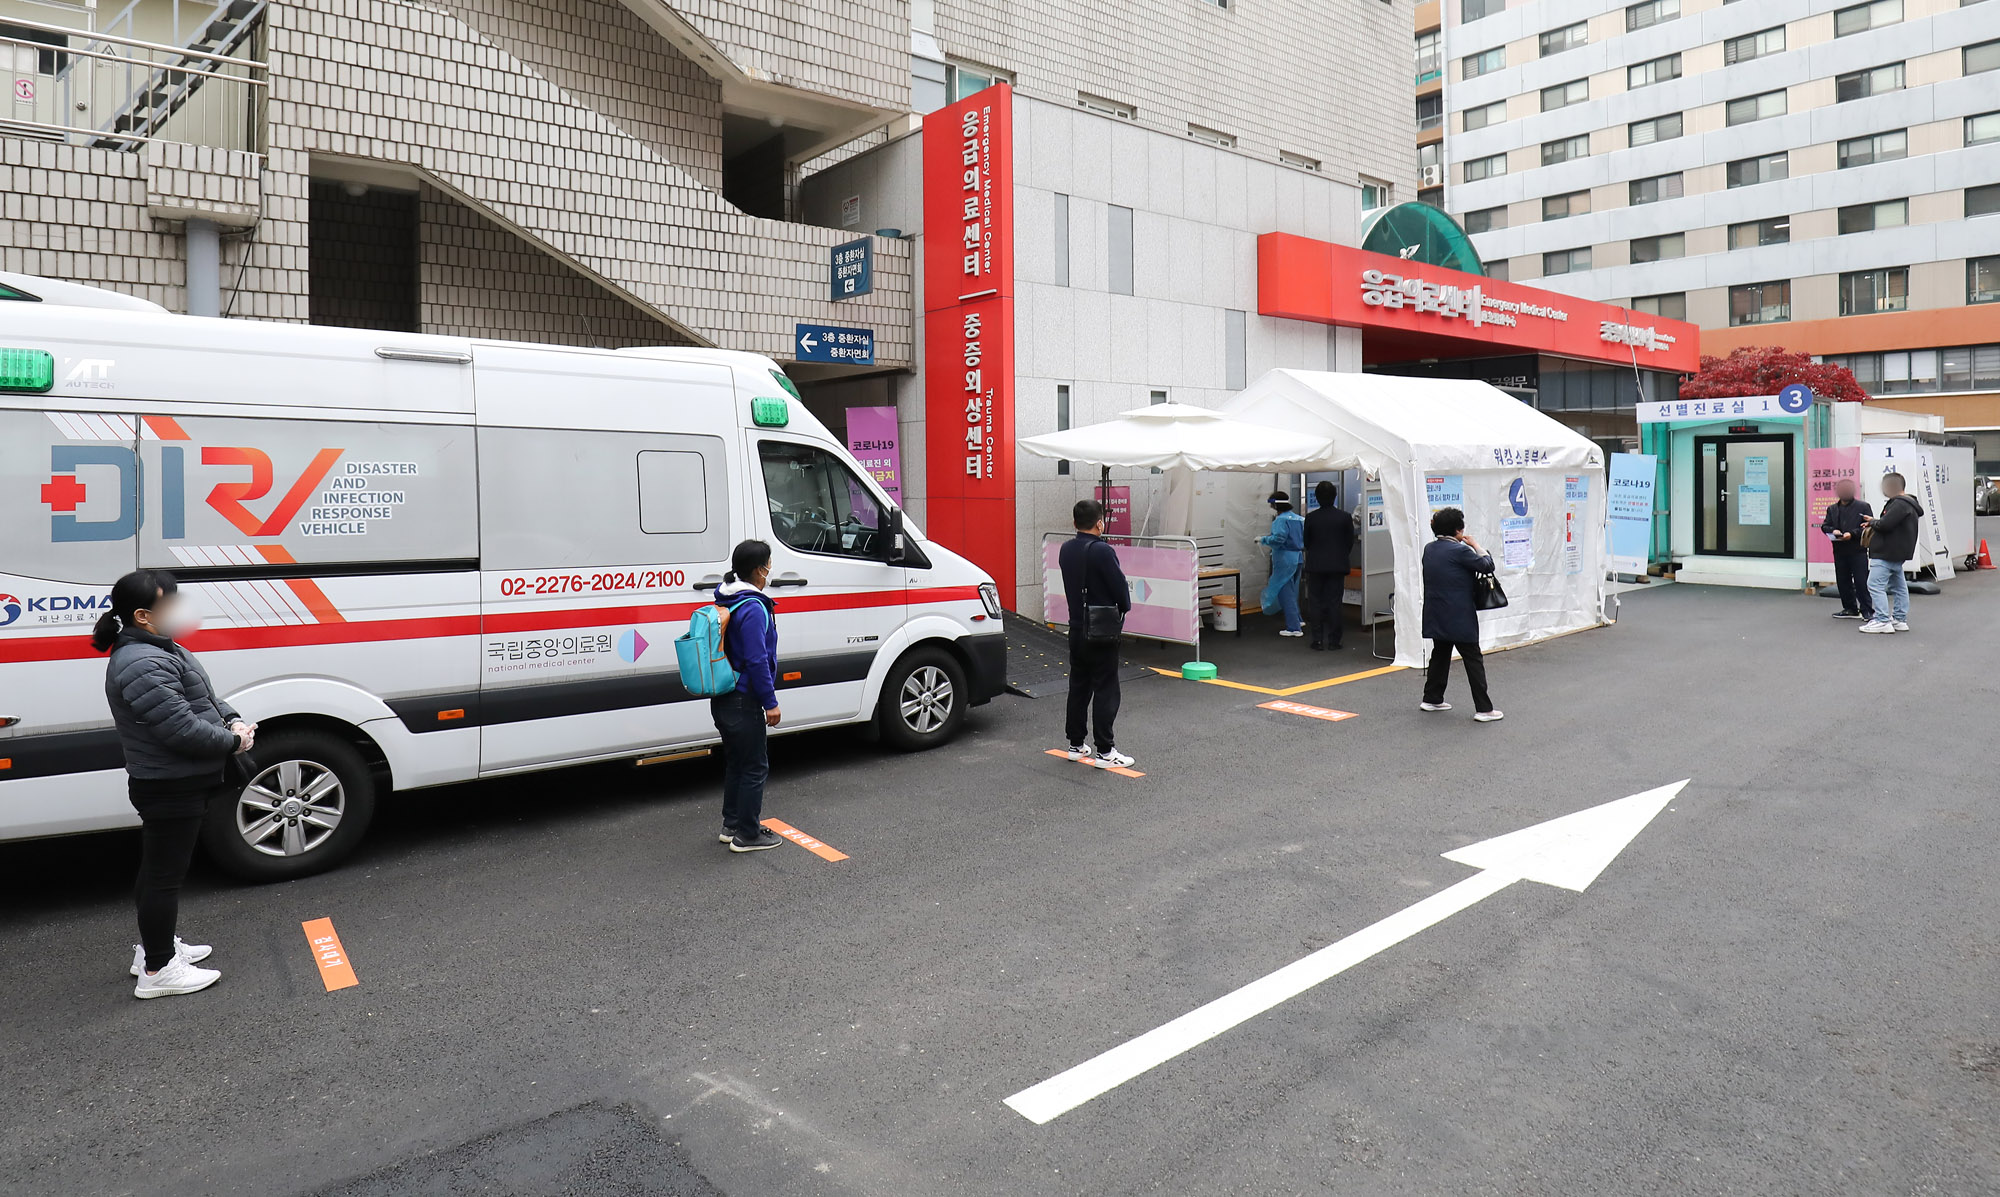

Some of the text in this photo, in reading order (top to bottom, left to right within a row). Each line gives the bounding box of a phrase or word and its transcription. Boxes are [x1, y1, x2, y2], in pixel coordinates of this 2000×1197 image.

[962, 110, 980, 277] 응급의료센터
[982, 106, 992, 274] Emergency Medical Center
[1481, 294, 1569, 321] Emergency Medical Center
[822, 332, 869, 346] 3층 중환자실
[830, 347, 869, 359] 중환자면회
[964, 313, 983, 479] 중증외상센터
[1789, 390, 1803, 408] 3
[1659, 400, 1770, 416] 선별진료실 1
[985, 388, 994, 479] Trauma Center
[853, 440, 894, 450] 코로나19
[1885, 447, 1894, 457] 1
[883, 459, 892, 467] 외
[1921, 456, 1926, 466] 2
[346, 463, 417, 474] DISASTER
[1812, 468, 1855, 478] 코로나19
[332, 478, 366, 489] AND
[1613, 479, 1651, 488] 코로나19
[323, 492, 404, 504] INFECTION
[1516, 485, 1526, 507] 4
[312, 507, 391, 519] RESPONSE
[301, 522, 365, 535] VEHICLE
[500, 570, 685, 596] 02-2276-2024/2100
[488, 634, 612, 661] 국립중앙의료원
[488, 657, 595, 673] national medical center
